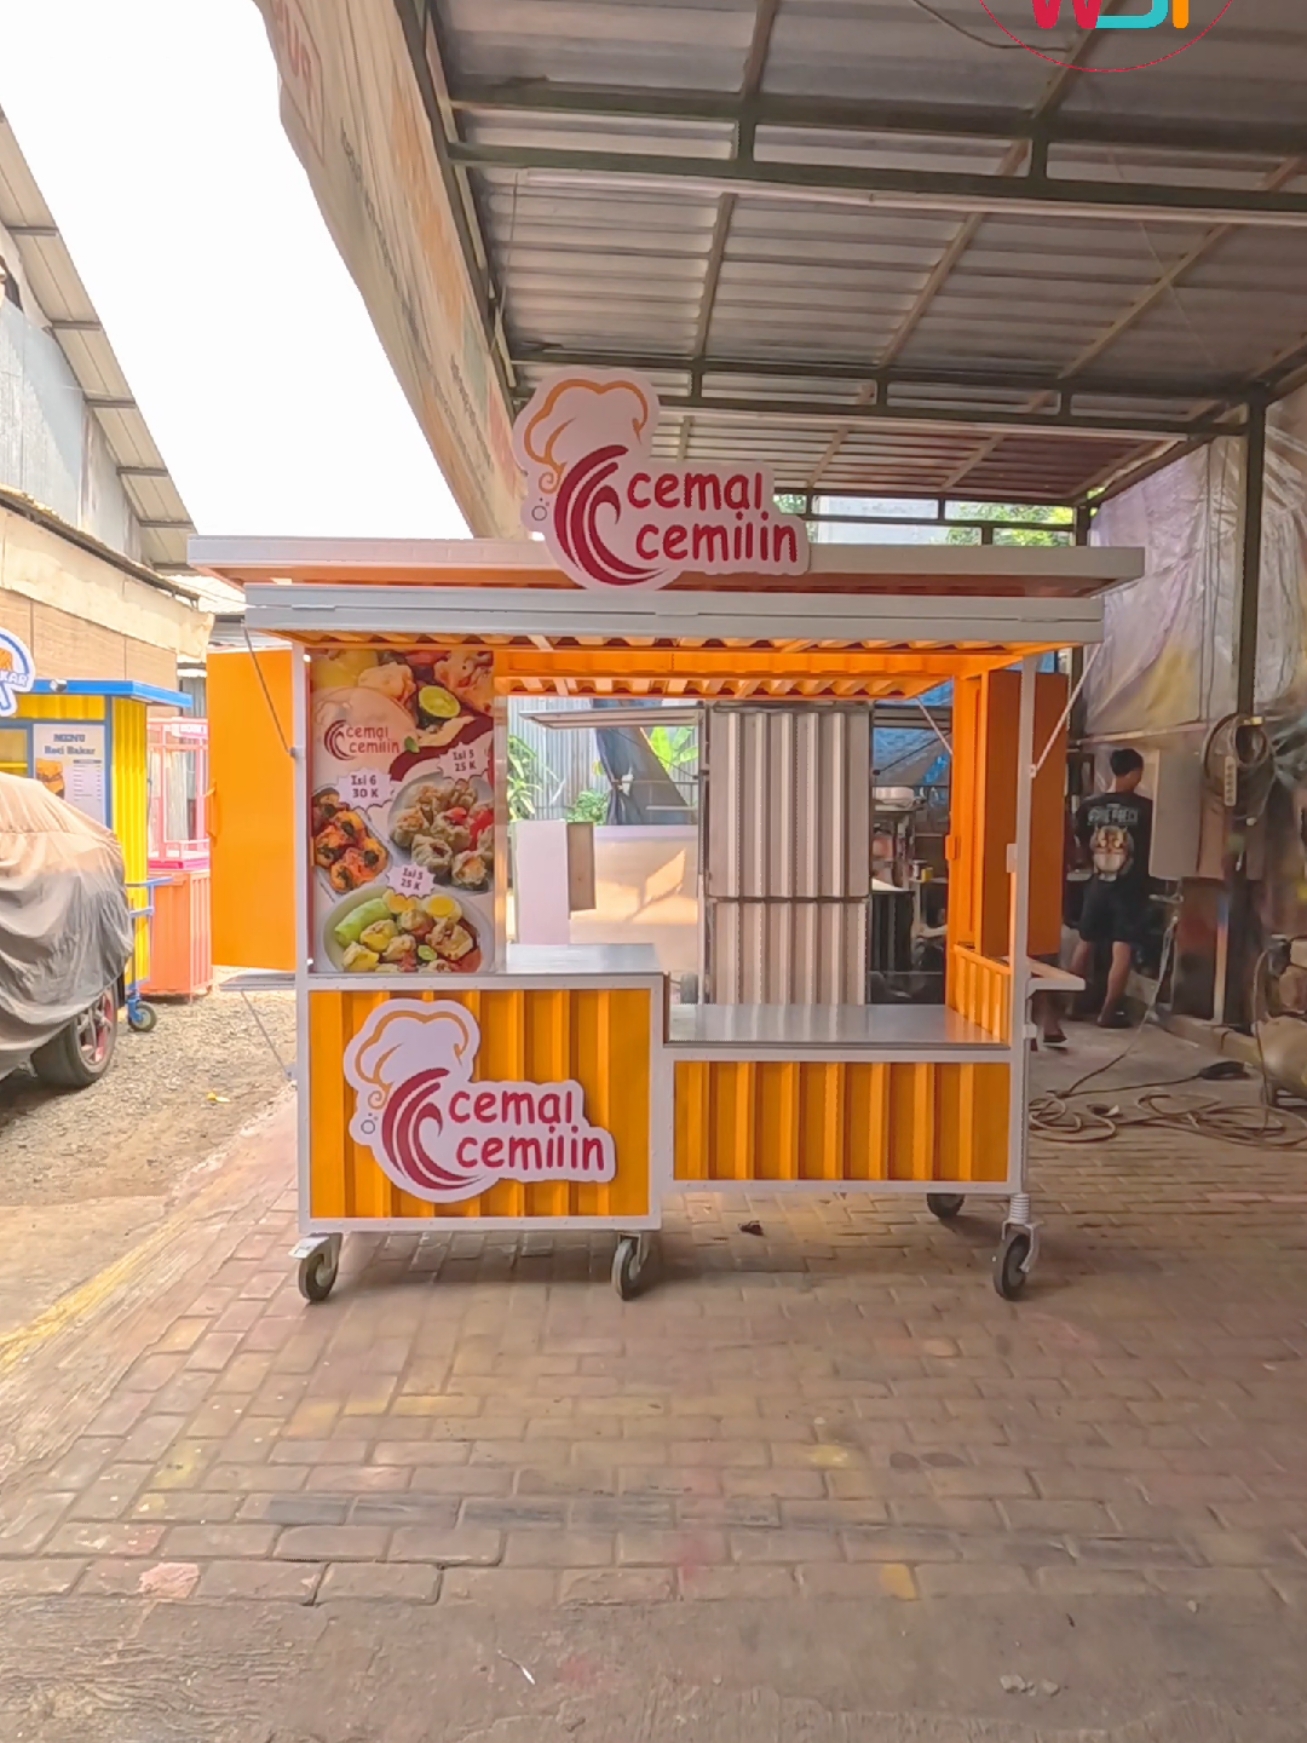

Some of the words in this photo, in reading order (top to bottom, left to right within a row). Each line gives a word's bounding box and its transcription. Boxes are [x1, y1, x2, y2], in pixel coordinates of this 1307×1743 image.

[635, 511, 797, 563] cemilin
[454, 762, 467, 772] 25
[469, 760, 477, 770] K
[350, 774, 367, 786] Isi
[369, 774, 377, 786] 6
[352, 788, 368, 799] 30
[370, 788, 379, 798] K
[414, 880, 422, 891] K
[456, 1126, 605, 1171] cemilin
